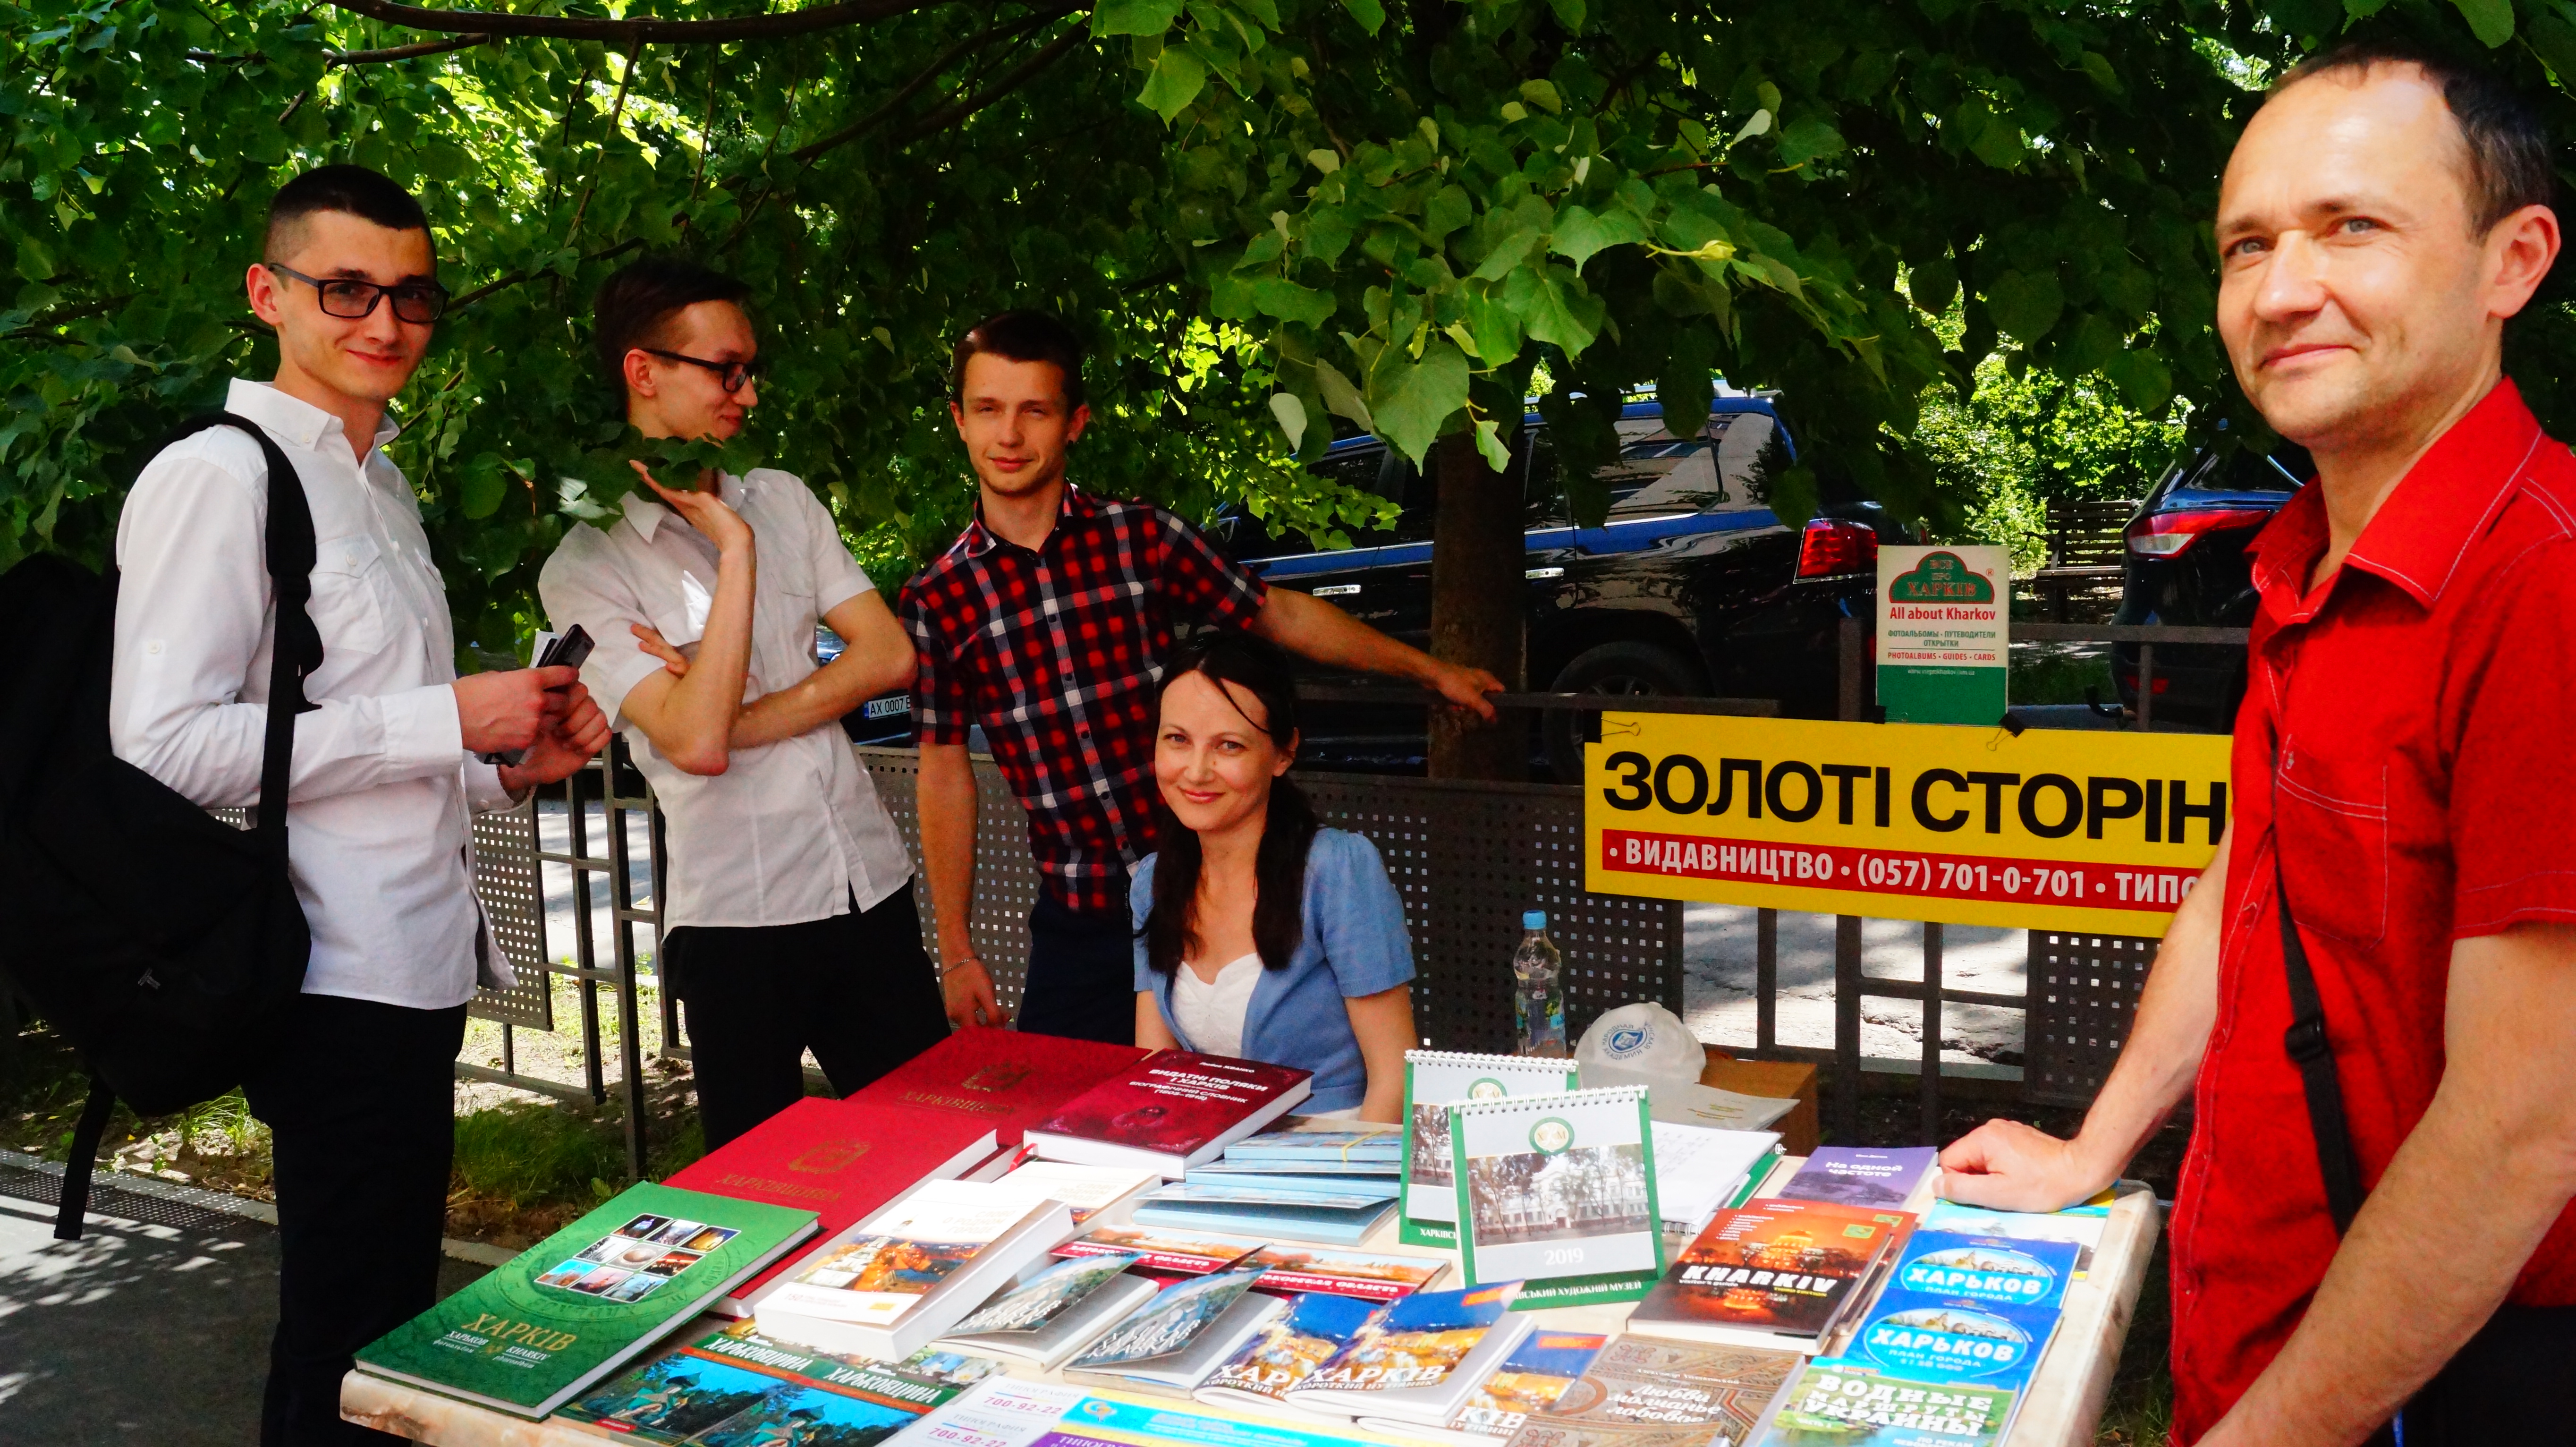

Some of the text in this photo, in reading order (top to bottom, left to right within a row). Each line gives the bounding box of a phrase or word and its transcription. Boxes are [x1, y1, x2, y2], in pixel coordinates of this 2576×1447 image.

[1907, 582, 1977, 597] ХАРКІВ
[1890, 607, 1996, 620] All about Kharkov
[1945, 630, 1996, 638] ПУТЕВОДИТЕЛИ
[1888, 652, 1936, 660] PHOTOALBUMS
[870, 701, 882, 715] AX
[885, 698, 904, 713] 0007
[1602, 750, 2227, 846] ЗОЛОТІ СТОРІН
[1626, 838, 1833, 882] ВИДАВНИЦТВО
[1857, 854, 1931, 891] (057)
[1939, 863, 2084, 898] 701-0-701
[1148, 1069, 1269, 1092] ВИДАТНІ ПОЛЯКИ
[1177, 1077, 1231, 1090] ХАРКІВ
[1200, 1091, 1249, 1103] СЛОВНИК
[1829, 1169, 1891, 1177] частоте
[1545, 1248, 1584, 1266] 2019
[1681, 1265, 1838, 1293] KHARKIV
[1907, 1268, 2042, 1295] ХАРЬКОВ
[1516, 1287, 1556, 1299] ІВСЬКИЙ
[1558, 1283, 1608, 1296] ХУДОЖНІЙ
[1609, 1280, 1642, 1291] МУЗЕЙ
[1925, 1285, 2013, 1301] ПЛАН ГОРОДА
[445, 1330, 489, 1345] ХАРЬКОВ
[460, 1313, 577, 1352] ХАРКІВ
[505, 1346, 551, 1361] KHARKIV
[703, 1337, 813, 1371] ХАРЬКОВЩИНА
[1870, 1328, 2014, 1362] ХАРЬКОВ
[1889, 1349, 1925, 1360] ПЛАН
[1929, 1354, 1982, 1368] ГОРОДА
[1302, 1365, 1446, 1384] ХАРКІВ
[822, 1367, 942, 1404] ХАРЬКОВЩИНА
[1815, 1374, 1993, 1412] ВОДНЫЕ
[1809, 1390, 1987, 1423] МАРШРУТЫ
[1454, 1406, 1527, 1429] КІВ
[1804, 1398, 1983, 1437] УКРАИНЫ
